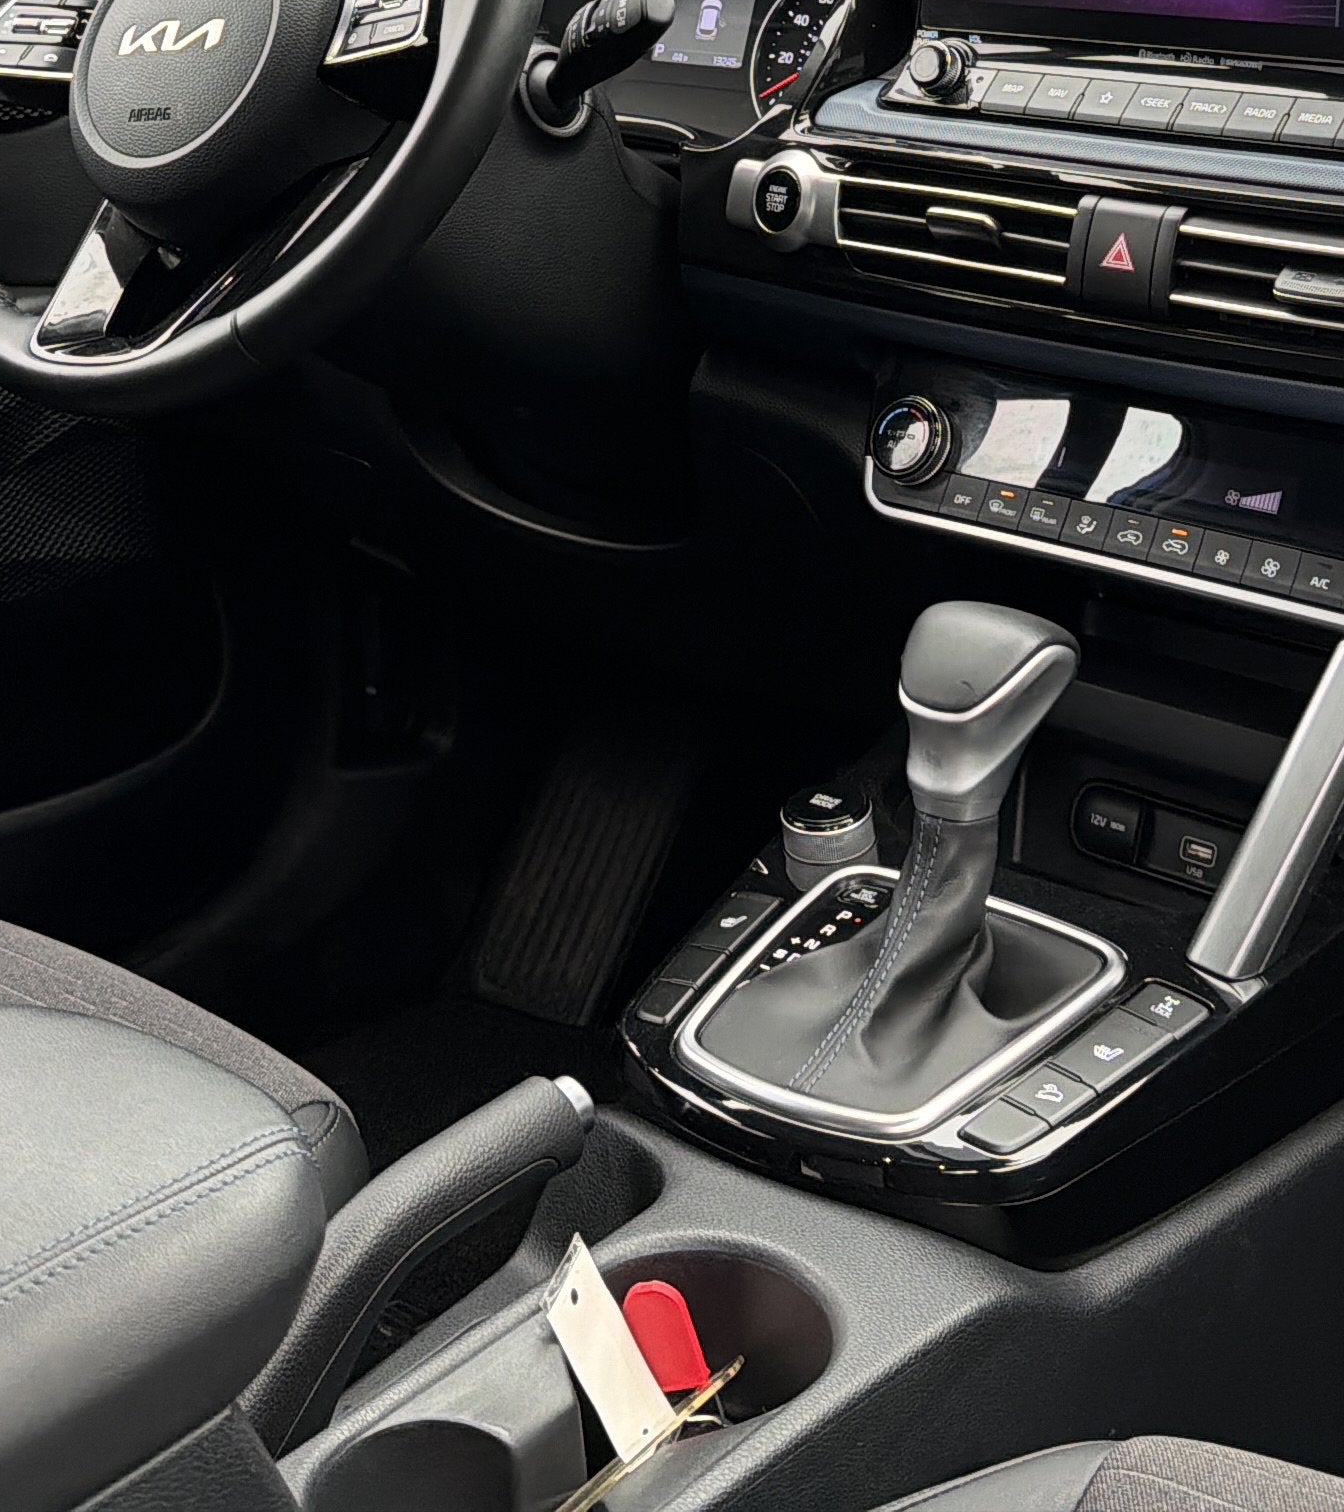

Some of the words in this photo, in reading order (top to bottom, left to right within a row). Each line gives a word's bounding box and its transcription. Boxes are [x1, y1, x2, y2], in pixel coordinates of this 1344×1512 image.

[793, 14, 810, 27] 40
[653, 43, 664, 57] P
[777, 51, 794, 64] 20
[1193, 54, 1215, 65] Radio
[1001, 83, 1024, 94] MAP
[1047, 87, 1069, 99] NAV
[128, 107, 172, 123] AIRBAG
[1243, 106, 1278, 119] RADIO
[1297, 112, 1333, 125] MEDIA
[765, 192, 788, 205] START
[766, 201, 785, 213] STOP
[953, 494, 972, 505] OFF
[1309, 576, 1331, 590] A/C
[1090, 812, 1107, 828] 12V
[1185, 865, 1203, 879] USB
[836, 910, 853, 921] P
[819, 923, 837, 937] R
[803, 938, 821, 950] N
